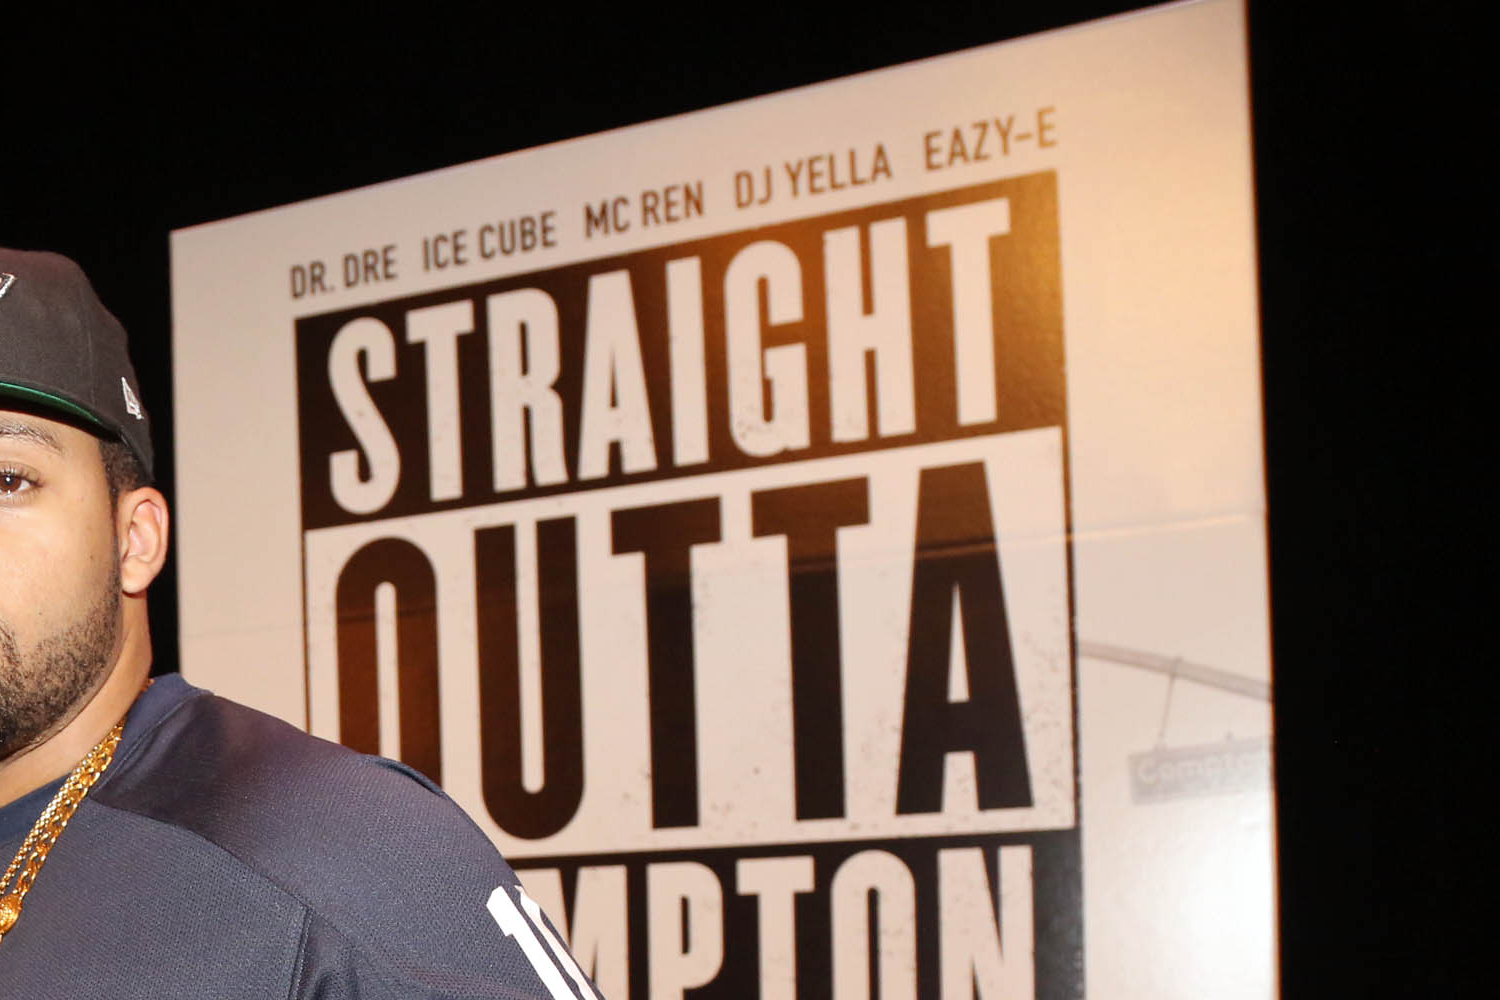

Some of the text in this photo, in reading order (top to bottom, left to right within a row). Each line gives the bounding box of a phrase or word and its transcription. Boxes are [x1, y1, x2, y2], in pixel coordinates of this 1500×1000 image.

[290, 106, 1058, 299] DR. DRE ICE CUBE MC REN DJ YELLA EAZY-E
[328, 197, 1013, 515] STRAIGHT
[335, 461, 1033, 840] OUTTA
